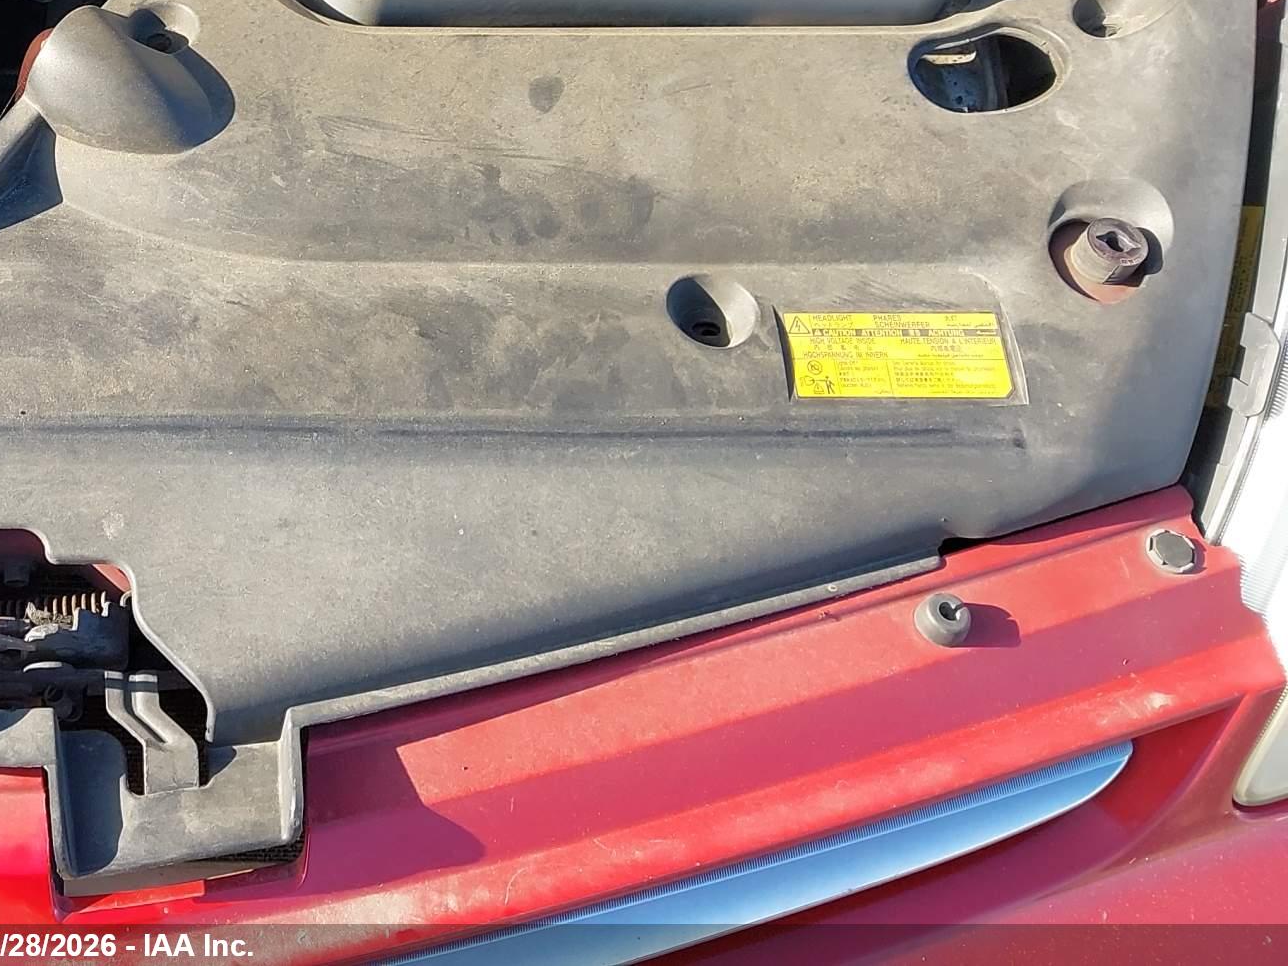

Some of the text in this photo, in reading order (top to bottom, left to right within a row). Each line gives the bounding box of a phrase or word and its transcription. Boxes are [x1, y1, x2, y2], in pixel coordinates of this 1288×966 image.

[824, 329, 856, 337] CAUTION
[861, 329, 902, 337] ATTENTION
[928, 329, 965, 337] ACHTUNG
